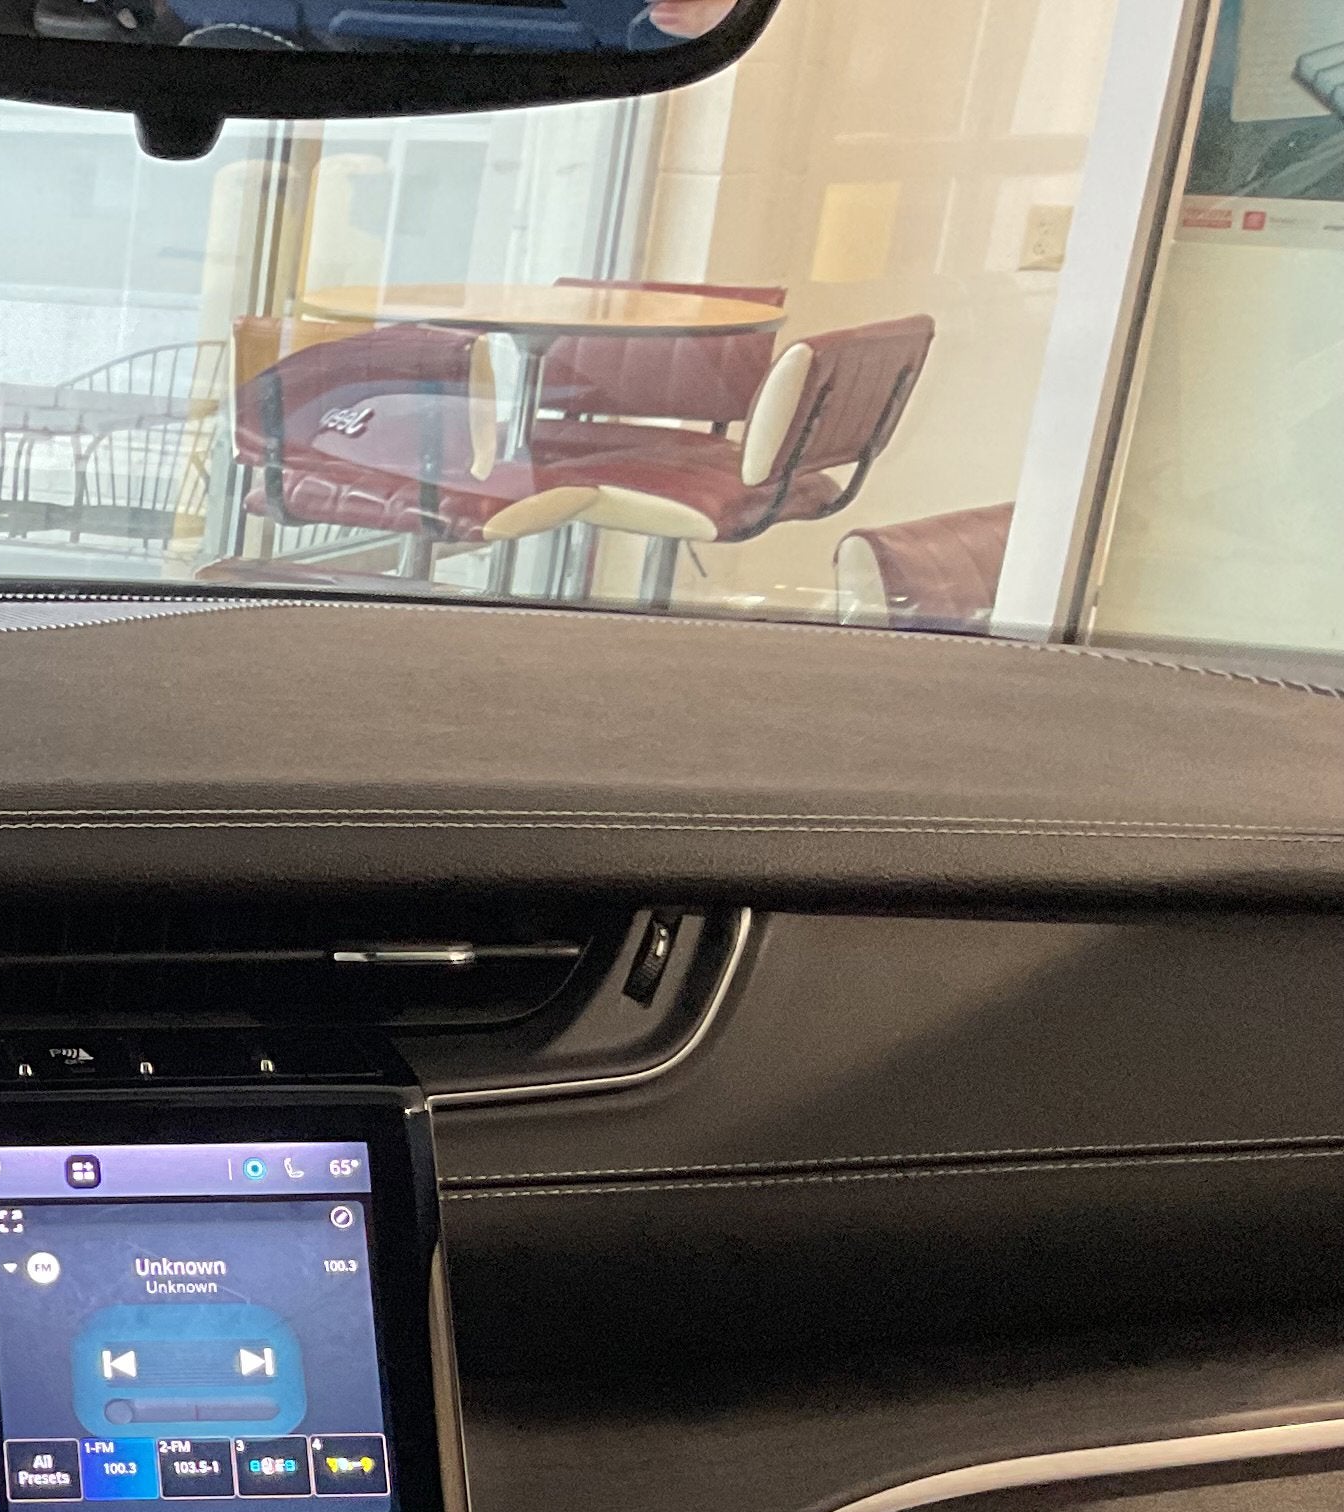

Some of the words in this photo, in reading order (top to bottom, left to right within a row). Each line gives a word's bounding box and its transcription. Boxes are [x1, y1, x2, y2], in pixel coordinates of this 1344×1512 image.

[34, 1263, 51, 1273] FM
[135, 1257, 227, 1276] Unknown
[324, 1260, 358, 1273] 100.3
[146, 1280, 218, 1294] Unknown
[84, 1441, 115, 1454] 1-FM
[159, 1440, 191, 1453] 2-FM
[235, 1439, 245, 1452] 3
[33, 1455, 53, 1469] All
[103, 1462, 137, 1475] 100.3
[18, 1470, 70, 1486] Presets
